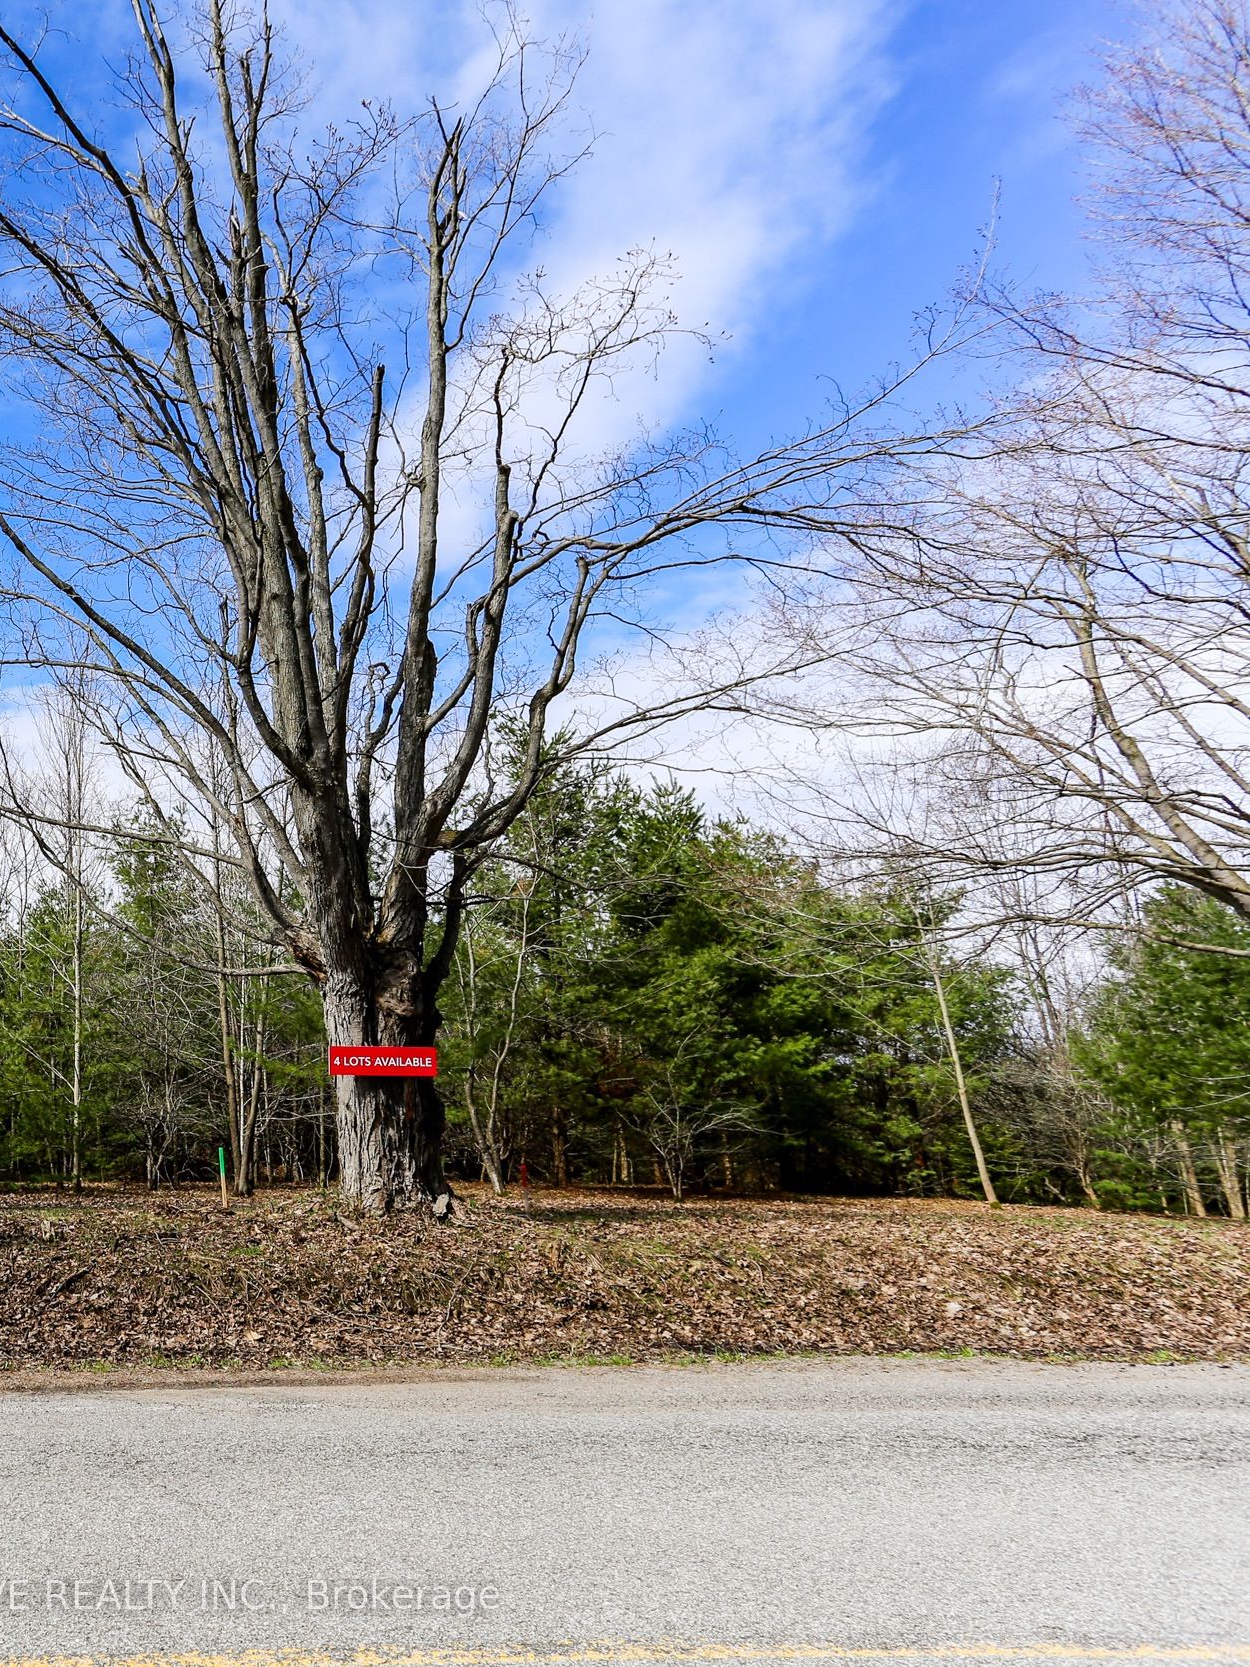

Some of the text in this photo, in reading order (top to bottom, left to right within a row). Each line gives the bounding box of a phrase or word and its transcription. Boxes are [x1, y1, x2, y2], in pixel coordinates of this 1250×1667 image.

[334, 1056, 432, 1067] 4 LOTS AVAILABLE
